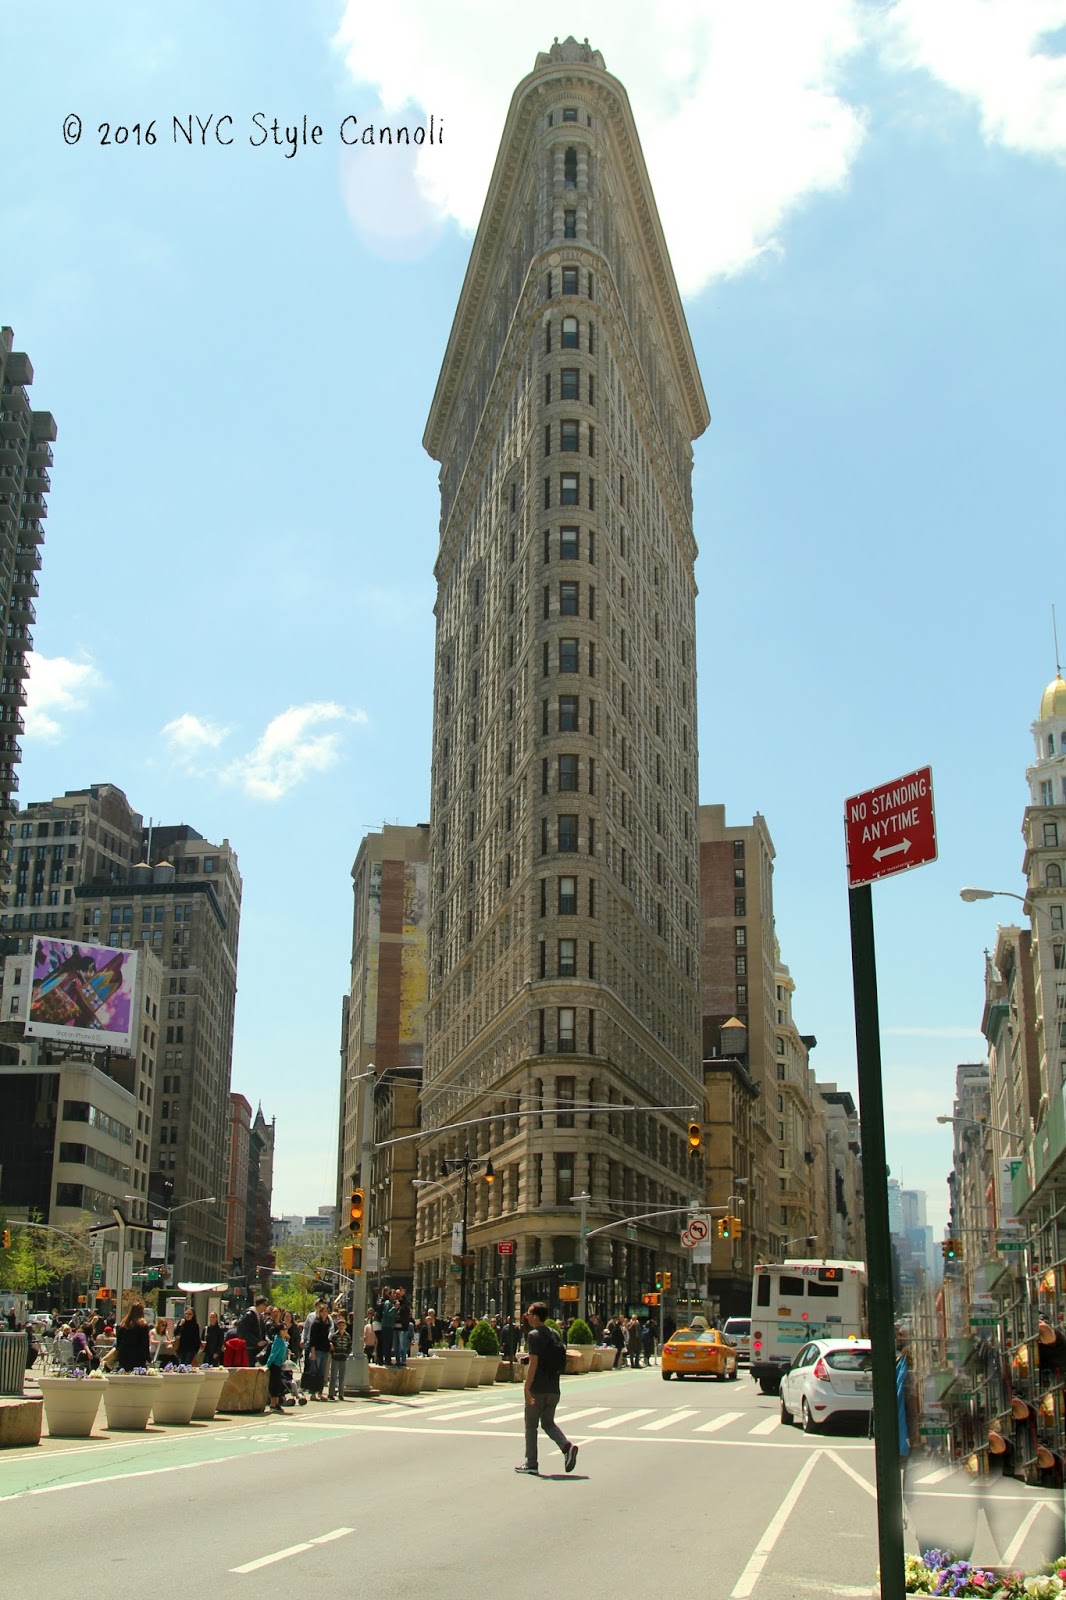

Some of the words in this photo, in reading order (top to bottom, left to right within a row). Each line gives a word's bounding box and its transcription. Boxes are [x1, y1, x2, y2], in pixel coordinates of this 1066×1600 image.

[851, 802, 867, 823] NO
[872, 778, 927, 815] STANDING
[861, 807, 920, 844] ANYTIME
